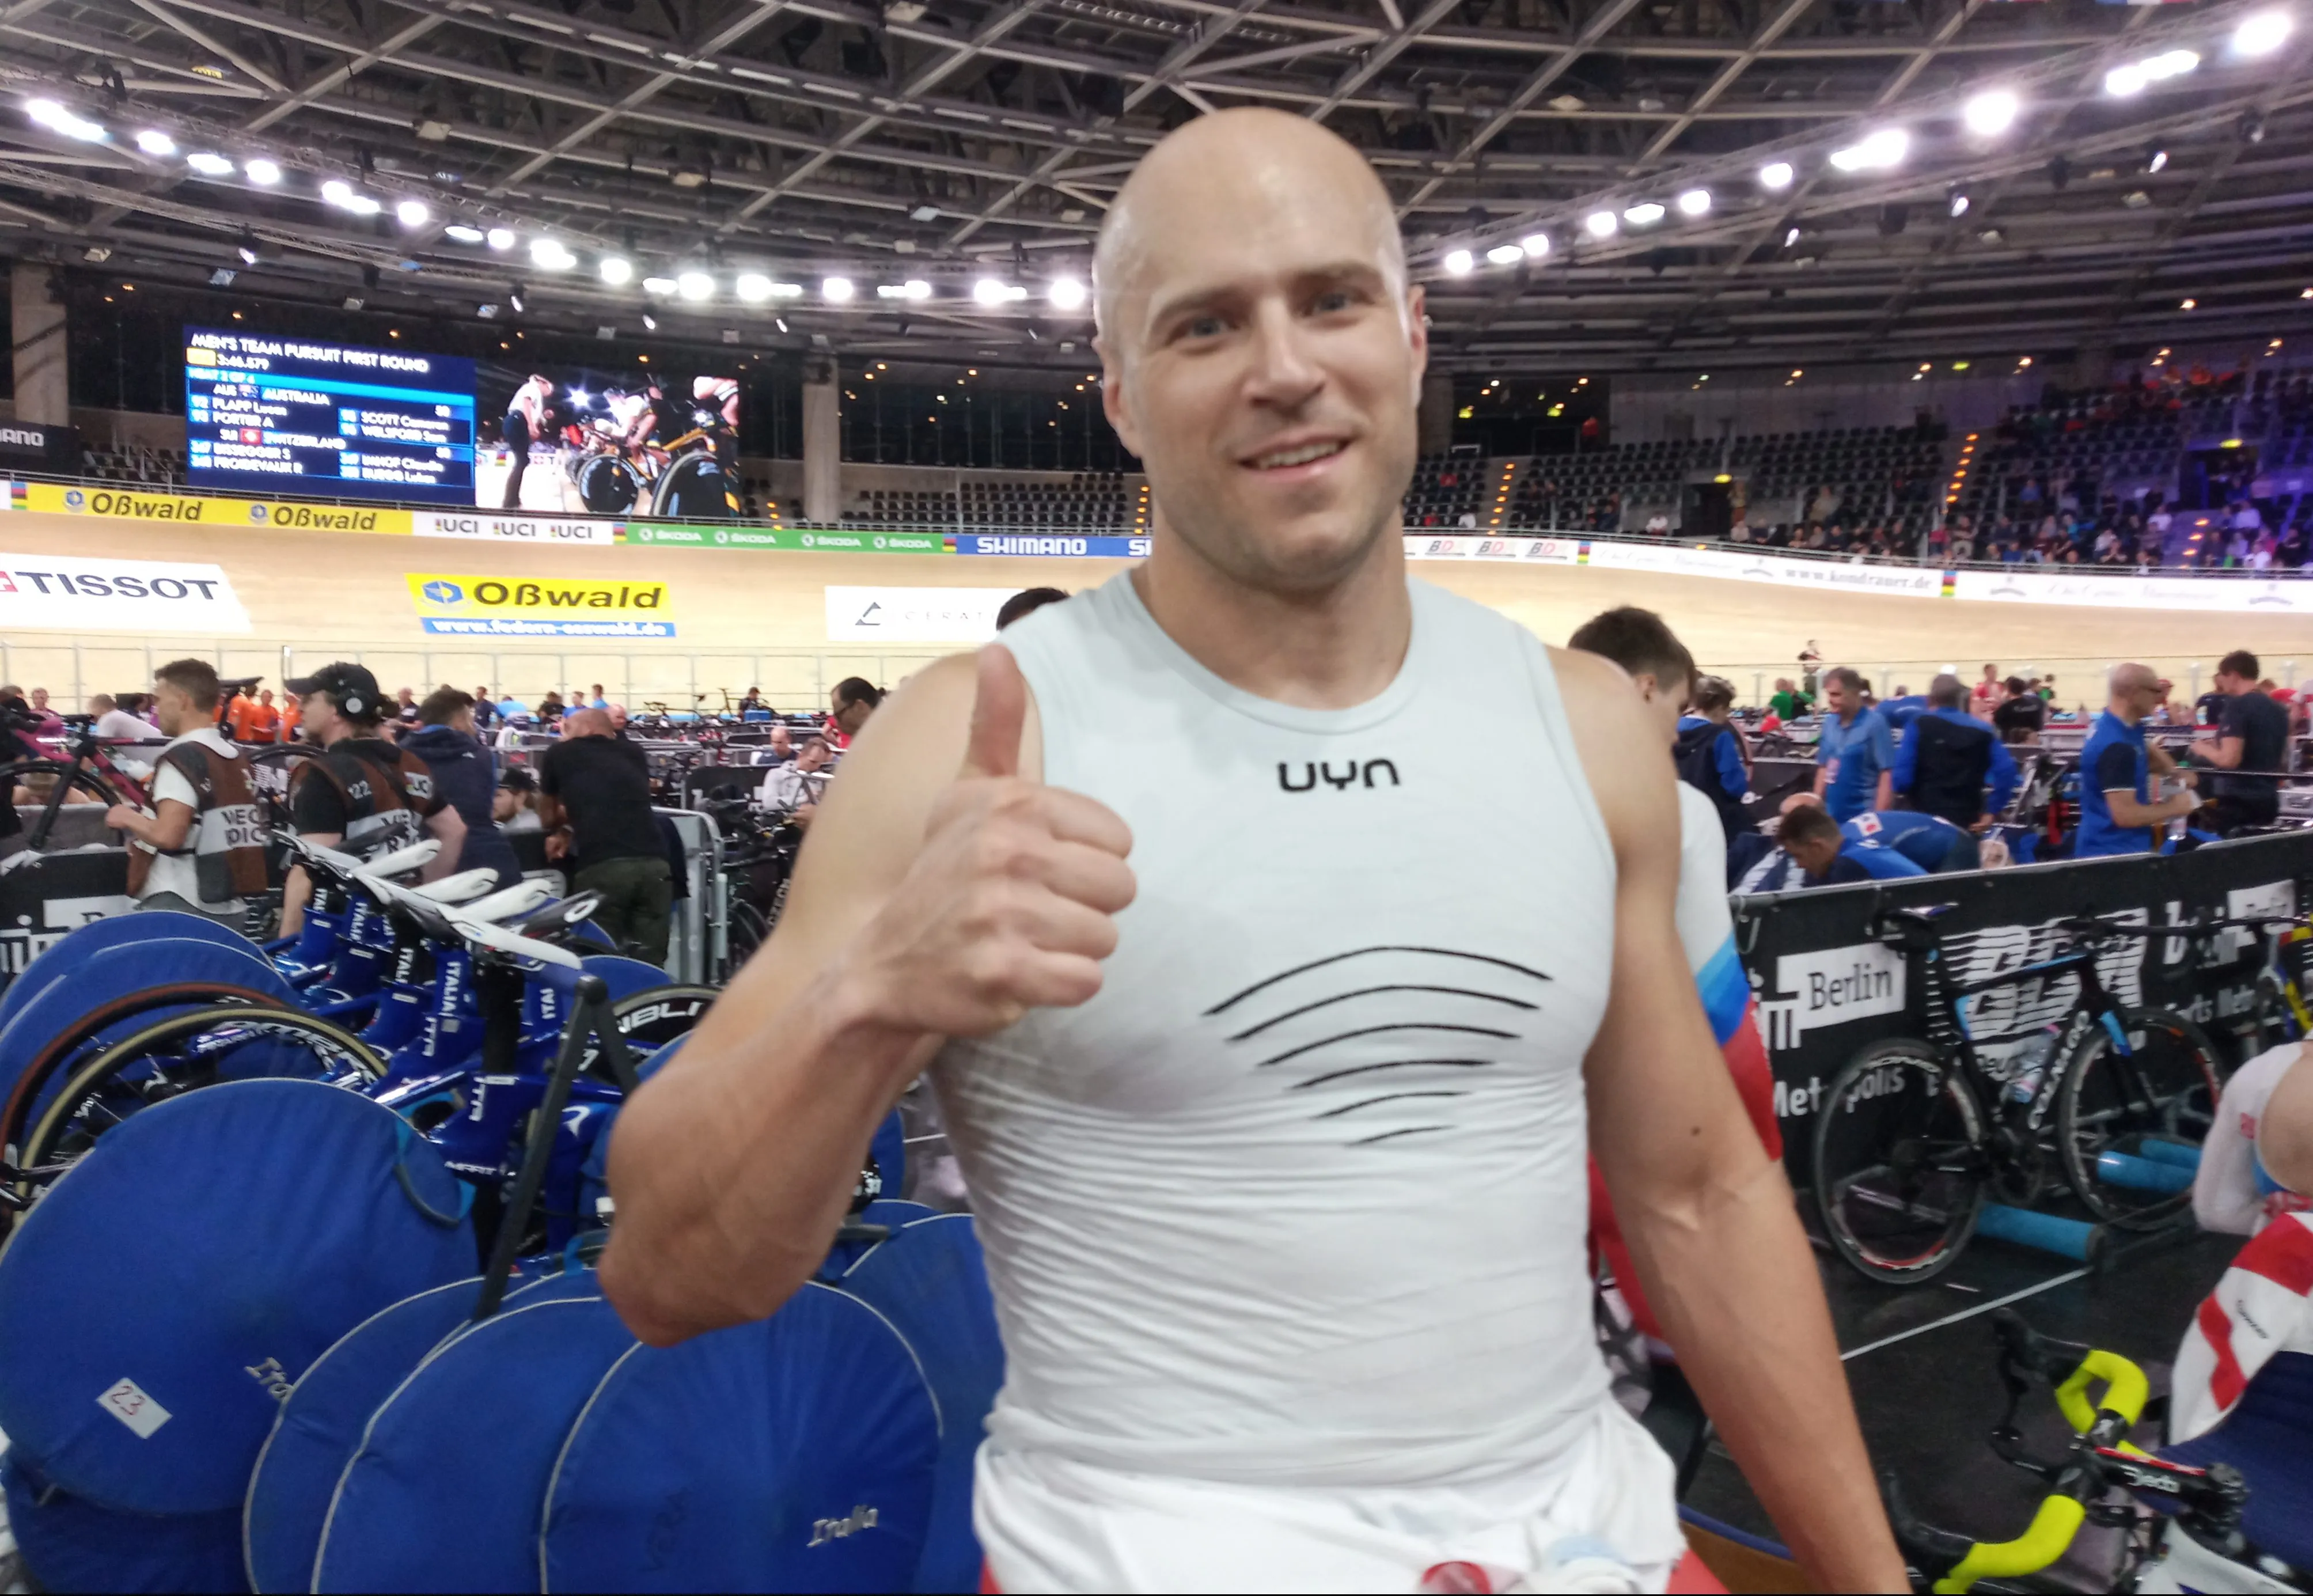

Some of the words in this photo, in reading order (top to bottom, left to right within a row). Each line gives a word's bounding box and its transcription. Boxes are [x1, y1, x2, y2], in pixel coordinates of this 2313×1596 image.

[239, 338, 283, 355] TEAM
[285, 344, 341, 362] PURSUIT
[343, 351, 377, 367] FIRST
[380, 356, 429, 373] ROUND
[262, 388, 330, 405] AUSTRALIA
[361, 411, 399, 426] SCOTT
[0, 429, 44, 446] ANO
[262, 430, 346, 450] SWITZERLAND
[92, 493, 202, 521] Oßwald
[274, 506, 377, 530] Oßwald
[443, 519, 479, 533] UCI
[501, 522, 536, 536] UCI
[558, 525, 592, 539] UCI
[977, 537, 1087, 555] SHIMANO
[15, 571, 218, 600] TISSOT
[474, 582, 662, 608] Oßwald
[1808, 962, 1894, 1011] Berlin
